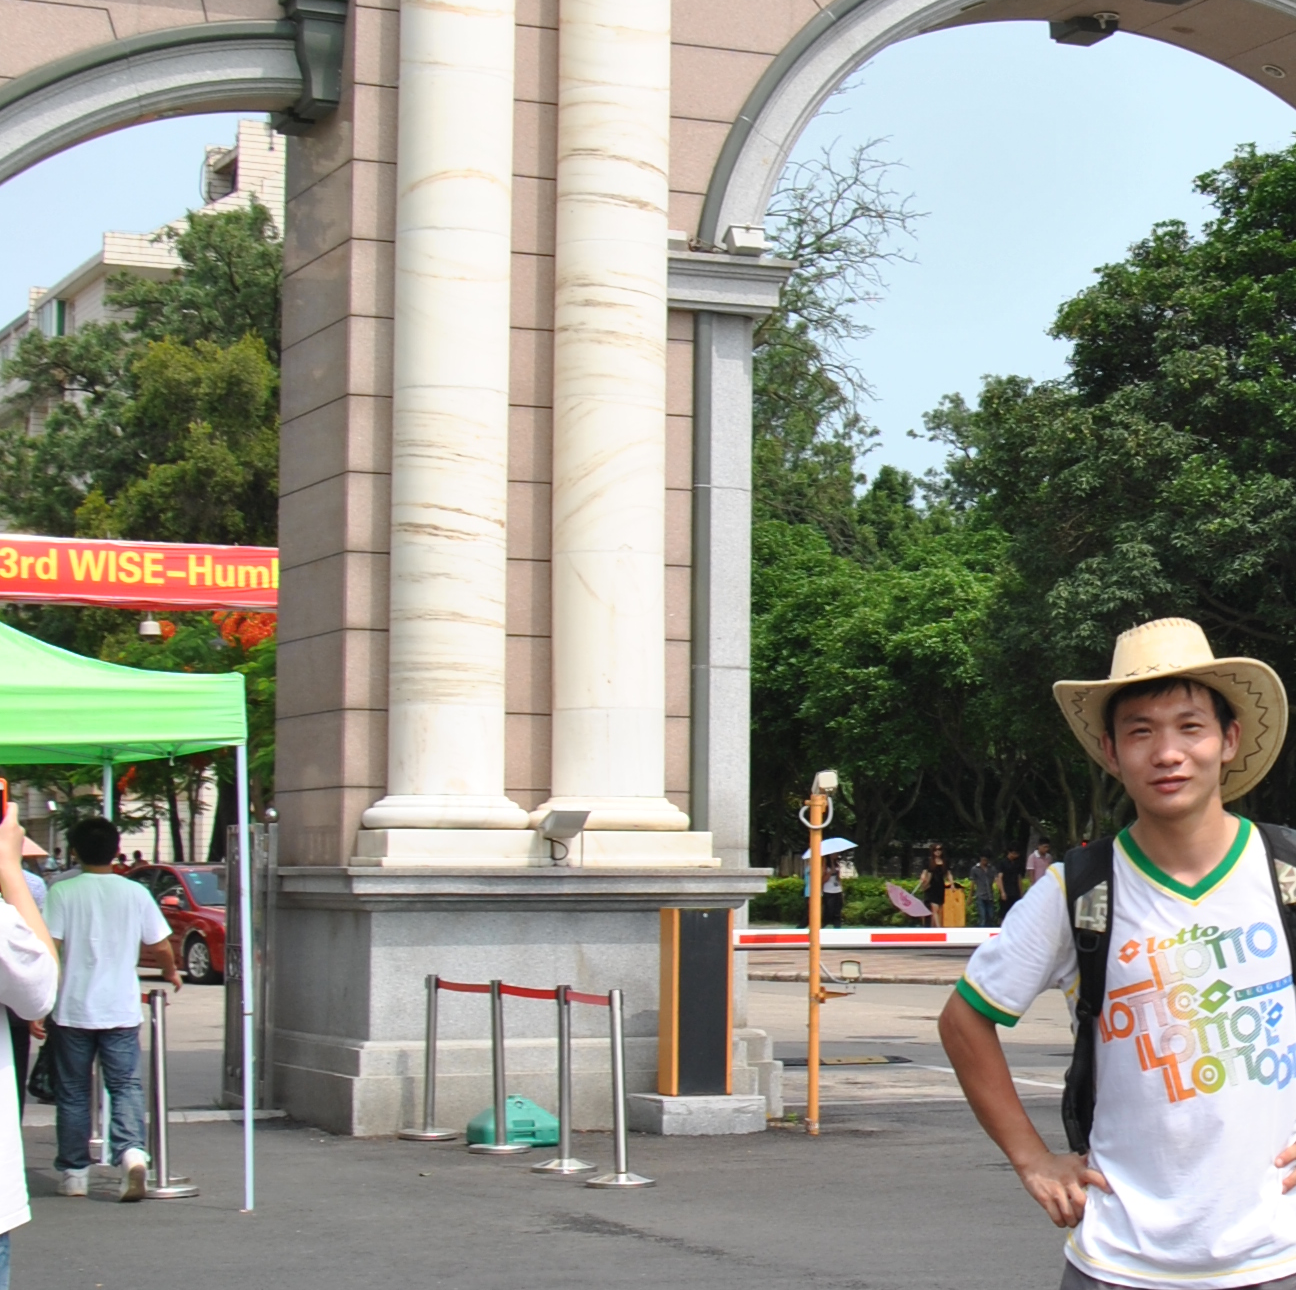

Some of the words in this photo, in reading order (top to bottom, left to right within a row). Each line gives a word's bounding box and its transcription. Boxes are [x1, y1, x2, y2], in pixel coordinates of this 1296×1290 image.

[0, 547, 58, 581] 3rd
[69, 548, 279, 589] WISE-Hum
[1146, 923, 1220, 955] lotto
